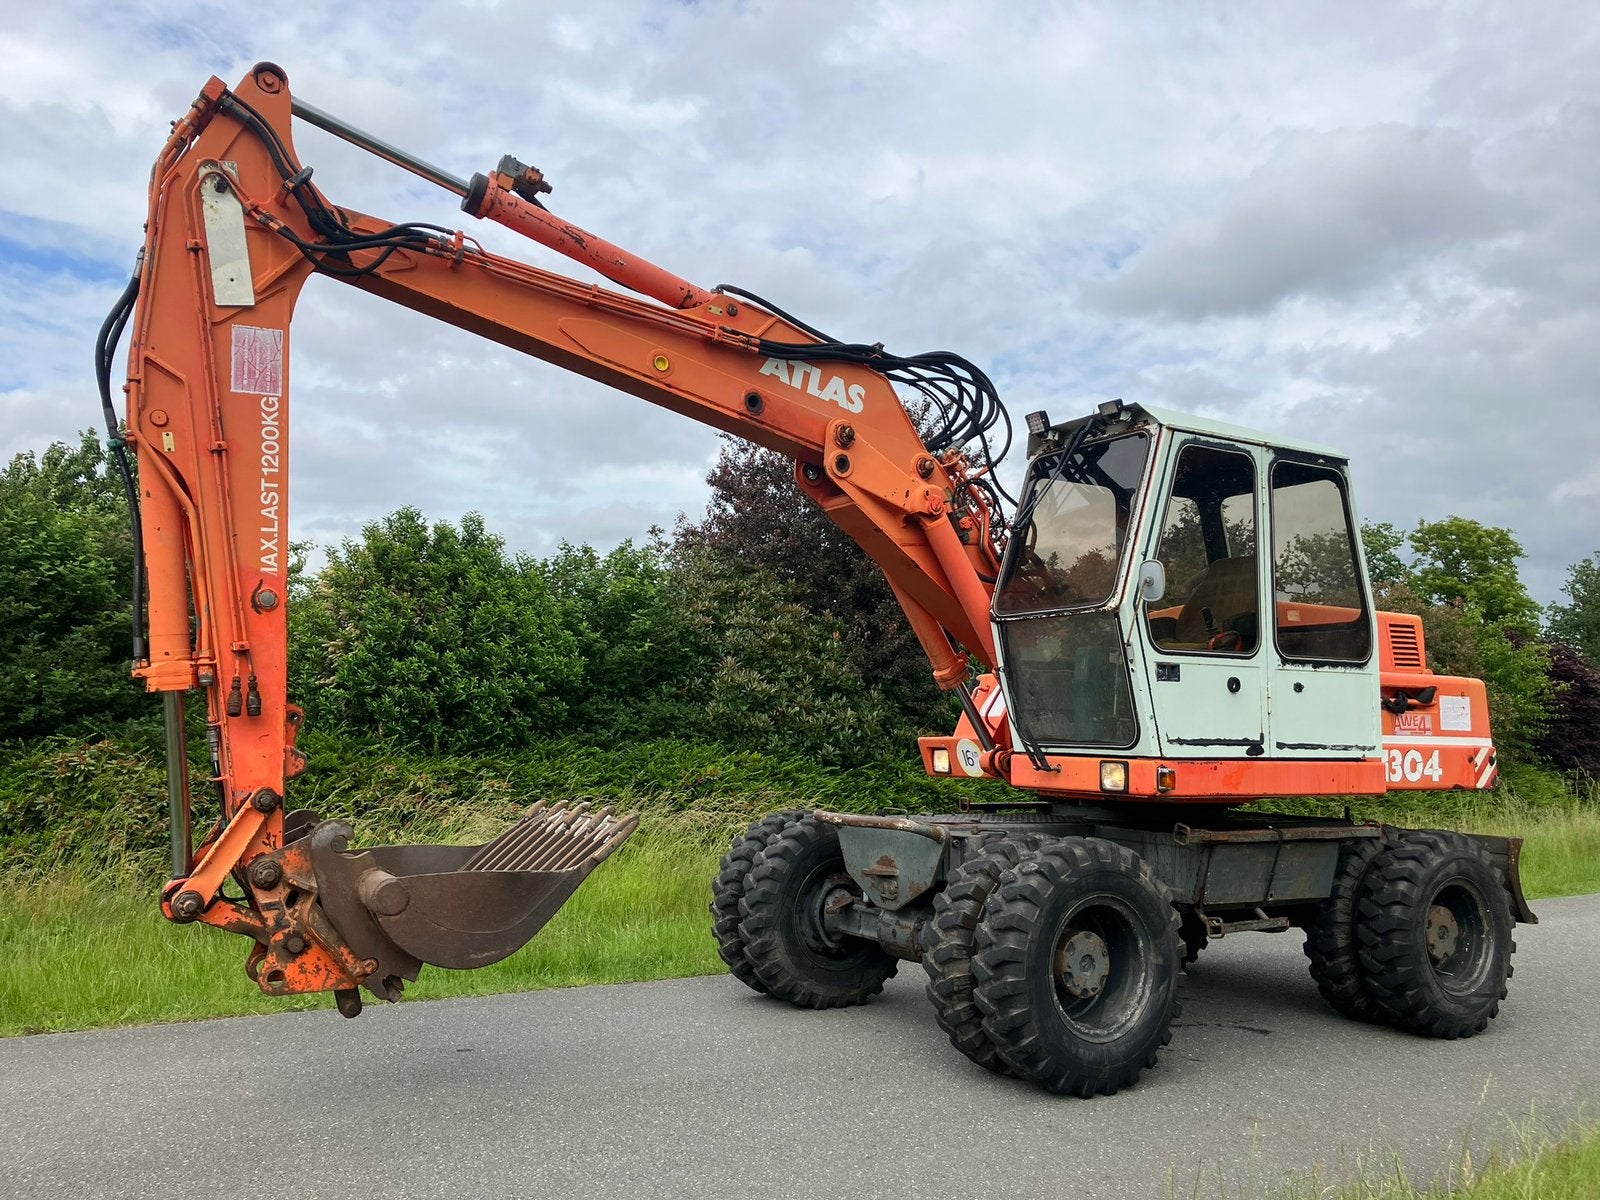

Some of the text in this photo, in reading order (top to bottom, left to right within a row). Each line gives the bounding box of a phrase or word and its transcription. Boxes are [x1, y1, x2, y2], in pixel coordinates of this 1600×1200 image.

[759, 357, 866, 414] ATLAS
[260, 396, 280, 476] 1200KG
[1382, 749, 1442, 782] 1304
